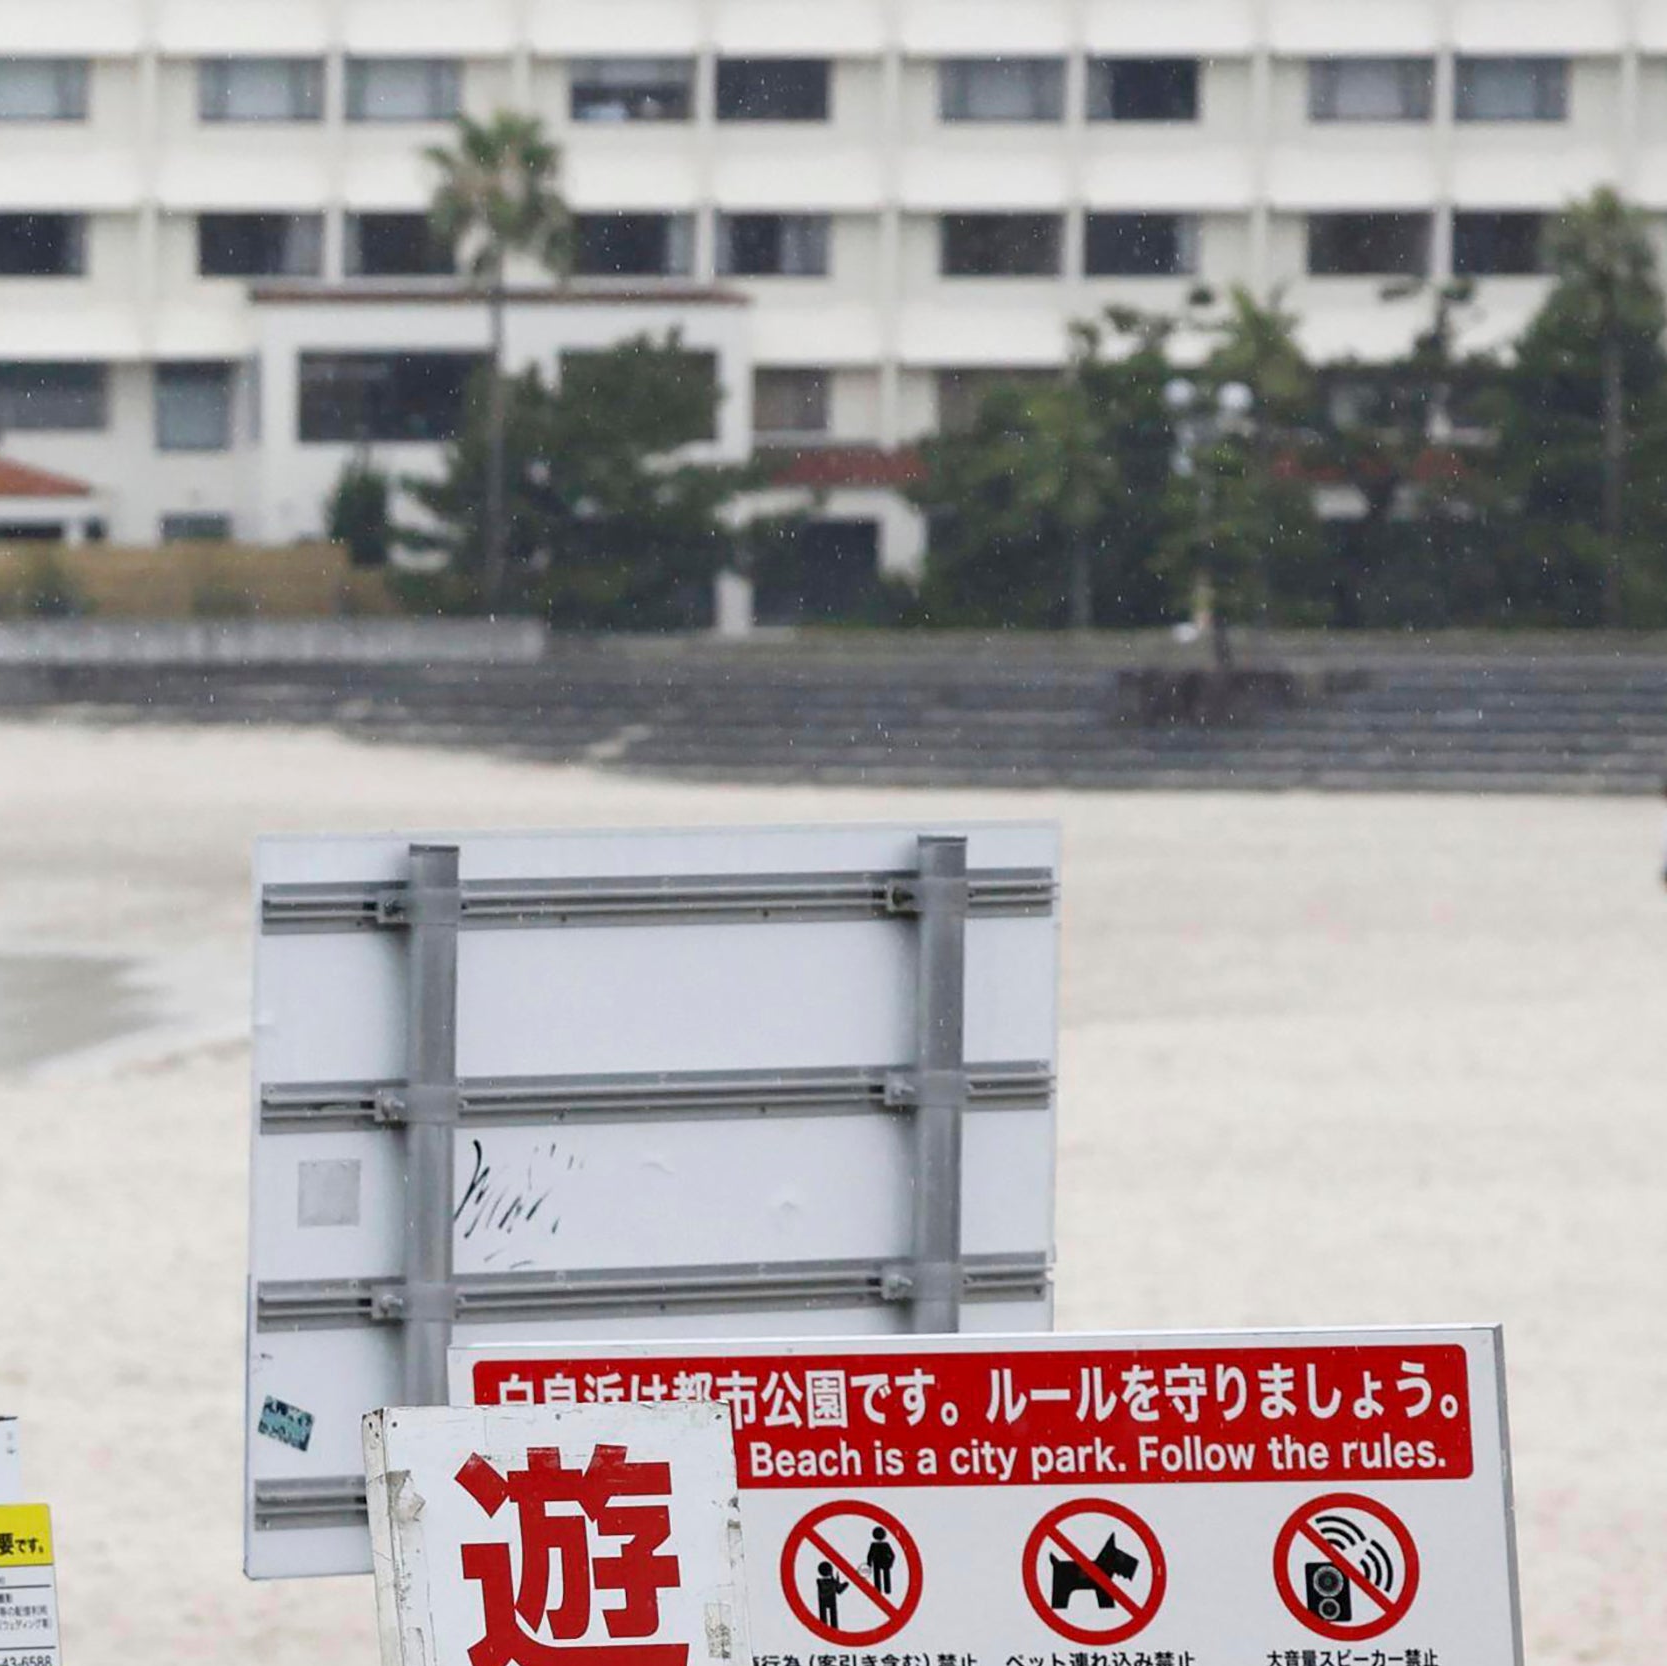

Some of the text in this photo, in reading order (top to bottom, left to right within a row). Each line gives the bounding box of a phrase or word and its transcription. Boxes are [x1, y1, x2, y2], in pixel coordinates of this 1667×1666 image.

[750, 1432, 1446, 1481] Beach is a city park. Follow the rules.
